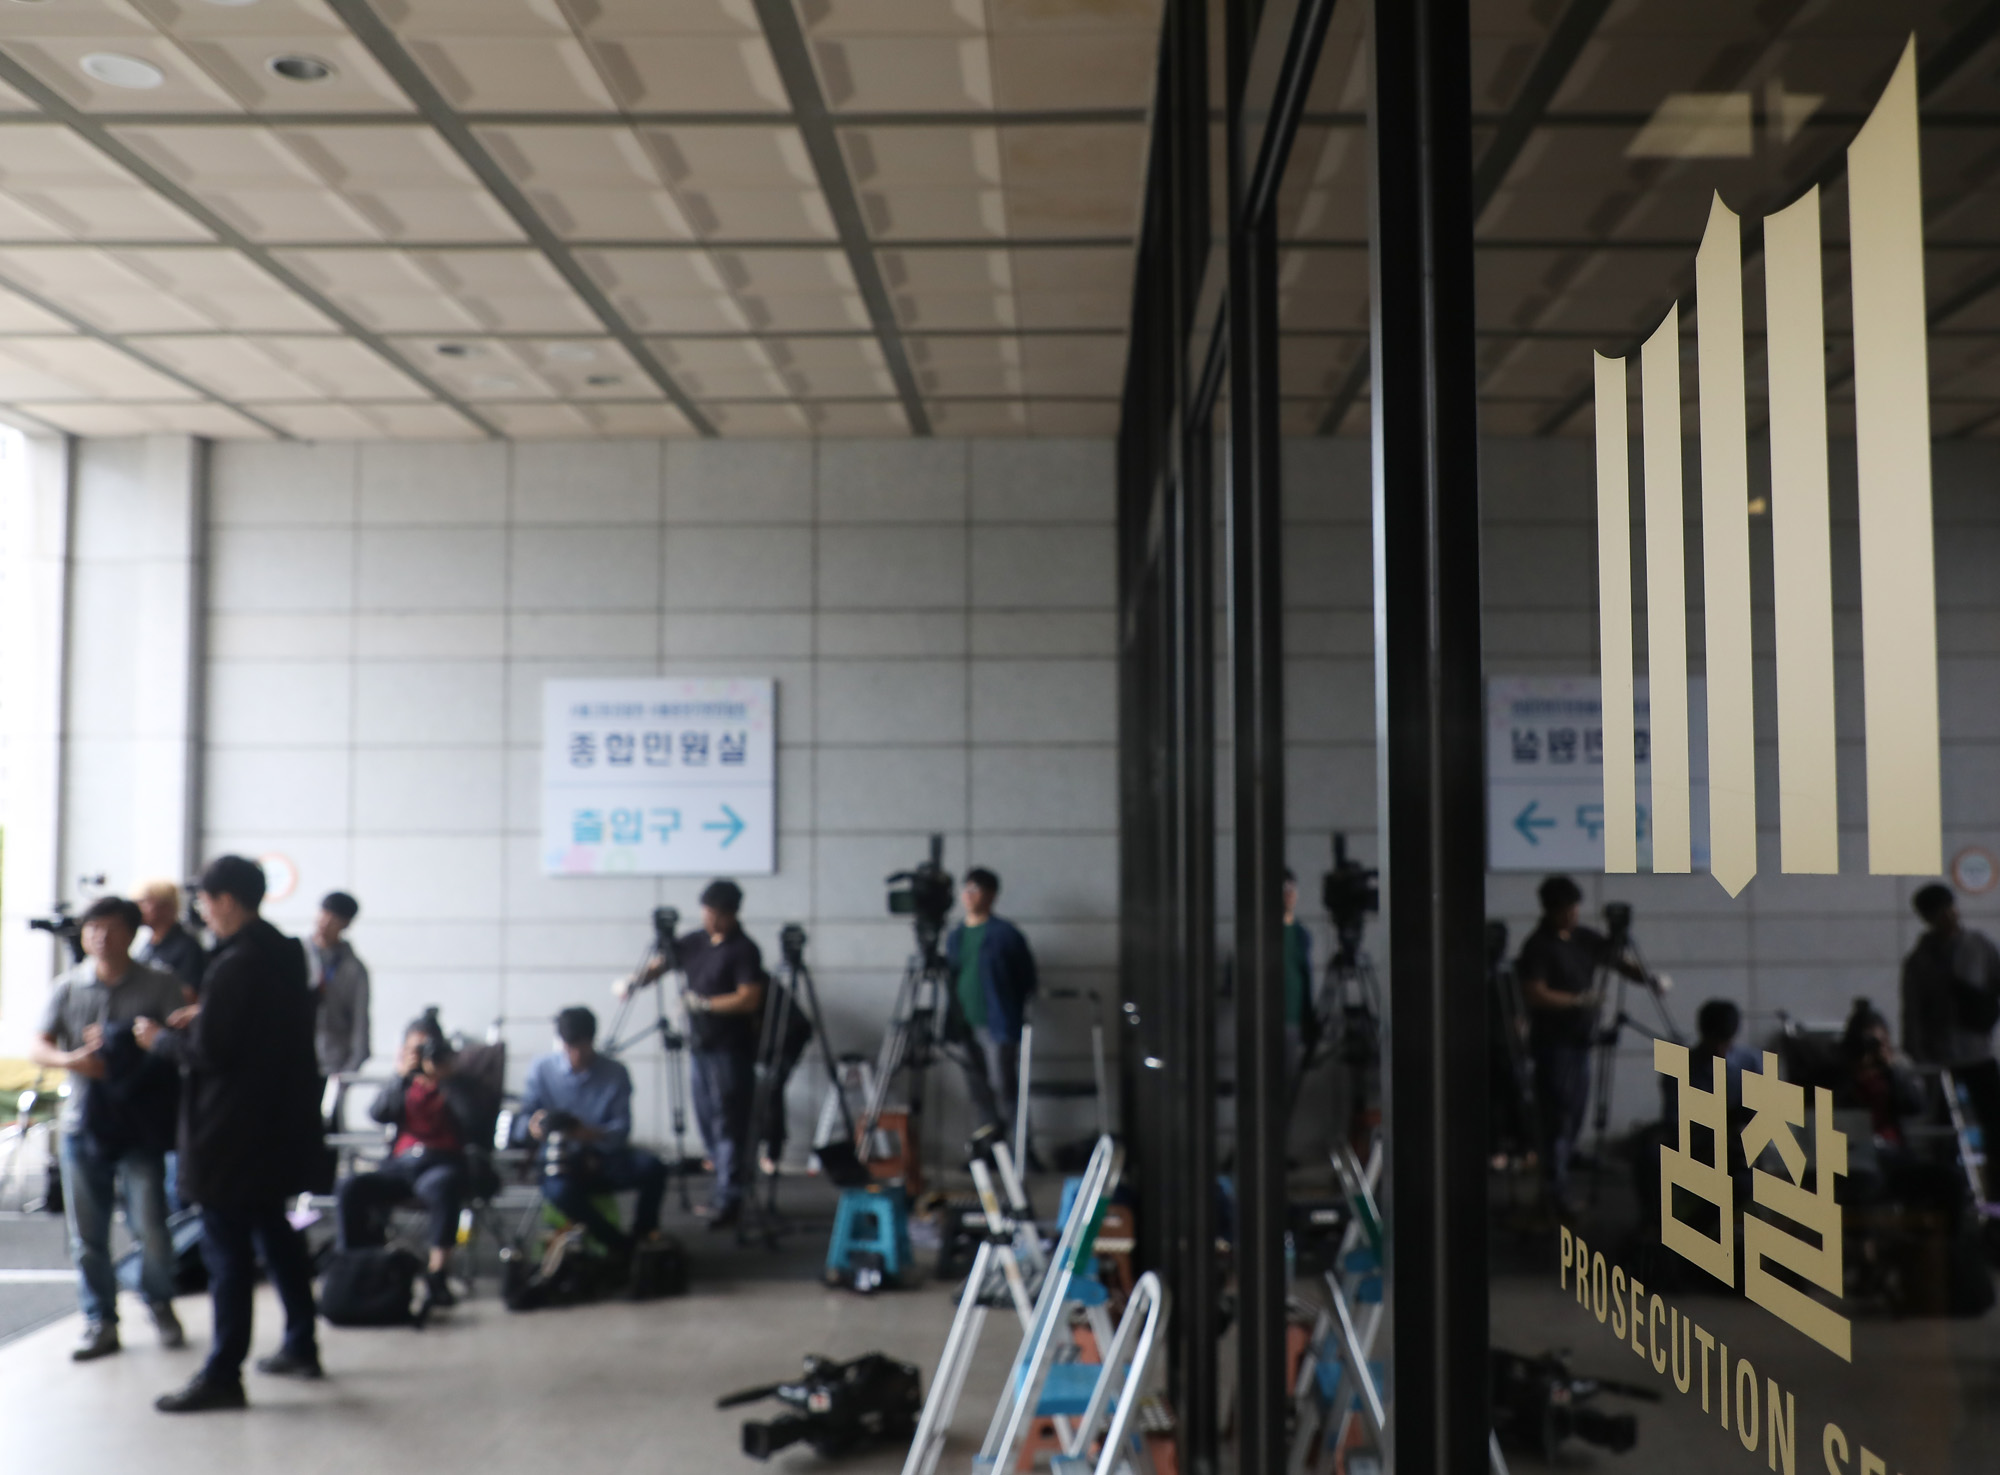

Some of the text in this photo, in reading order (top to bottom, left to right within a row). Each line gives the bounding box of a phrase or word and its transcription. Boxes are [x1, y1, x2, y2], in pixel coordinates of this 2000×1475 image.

[570, 730, 747, 768] 종합민원실
[572, 807, 682, 844] 출입구
[1653, 1038, 1852, 1364] 검찰
[1560, 1224, 1795, 1475] PROSECUTION
